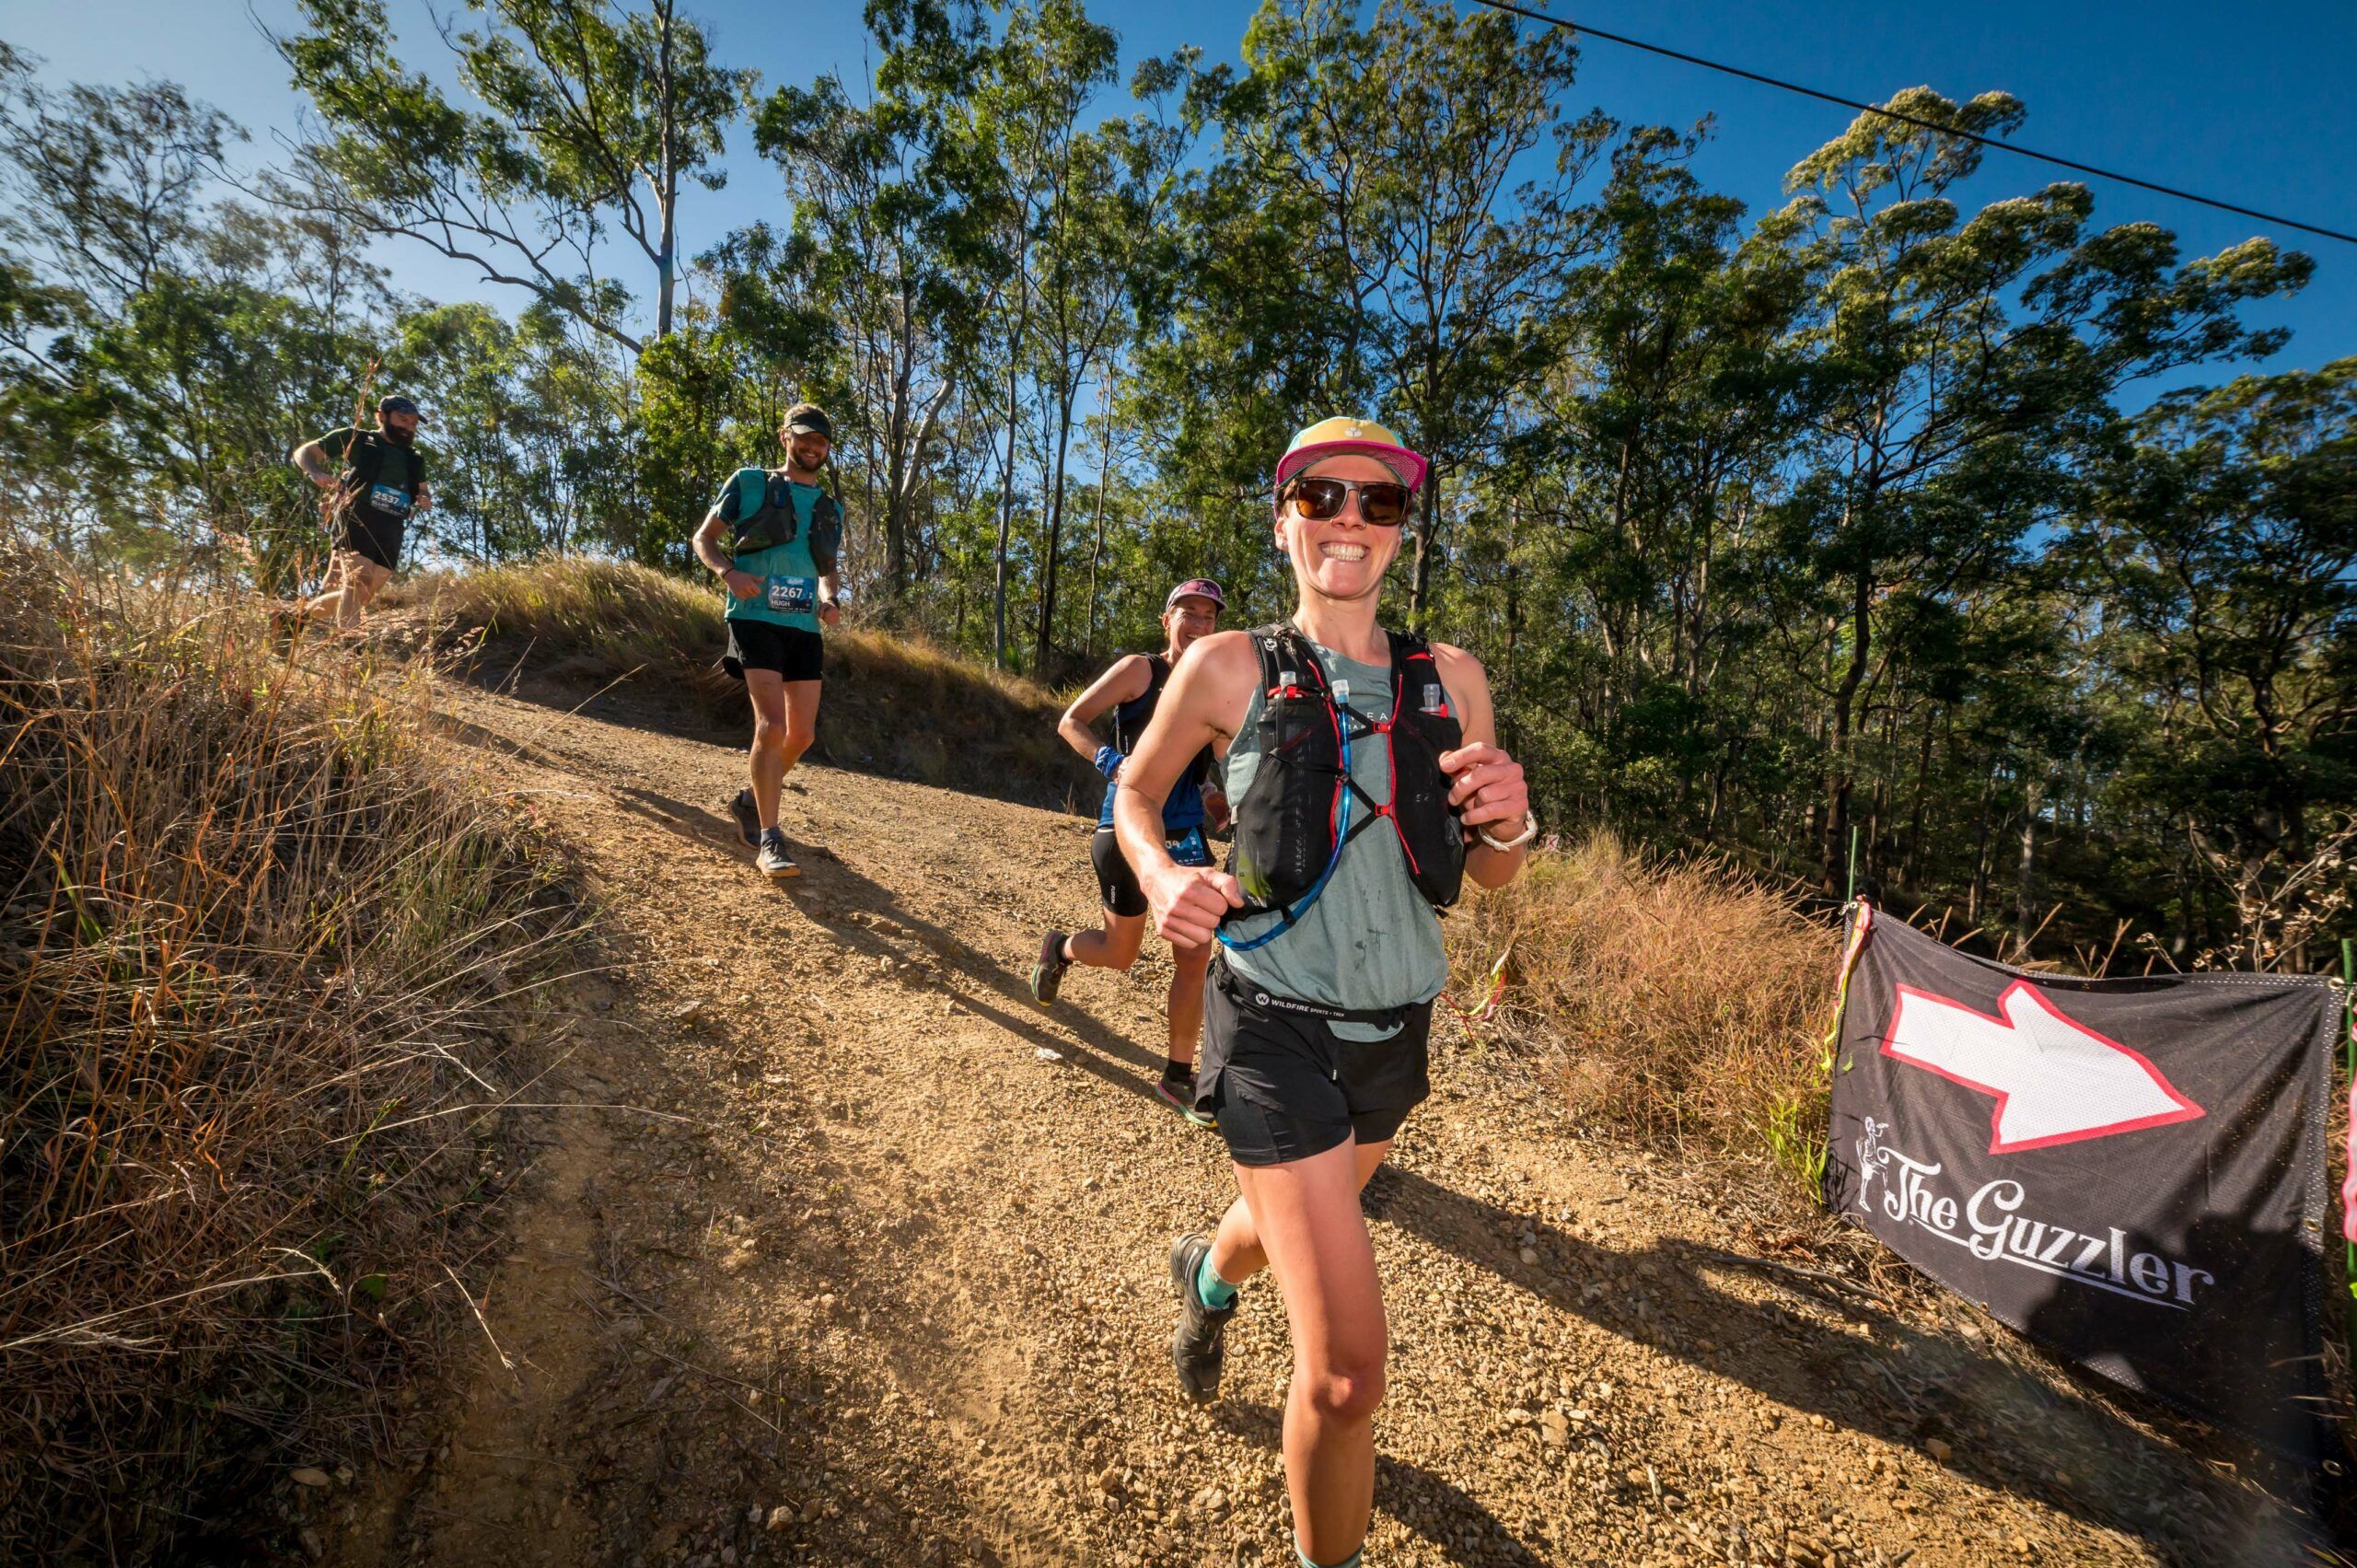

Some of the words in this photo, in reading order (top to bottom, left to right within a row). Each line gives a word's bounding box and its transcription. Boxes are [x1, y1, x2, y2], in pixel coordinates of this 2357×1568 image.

[374, 491, 400, 505] 2537
[772, 586, 802, 598] 2267
[1271, 999, 1309, 1012] WILDFIRE
[1877, 1145, 1958, 1230] The
[1967, 1179, 2215, 1305] Guzzler
